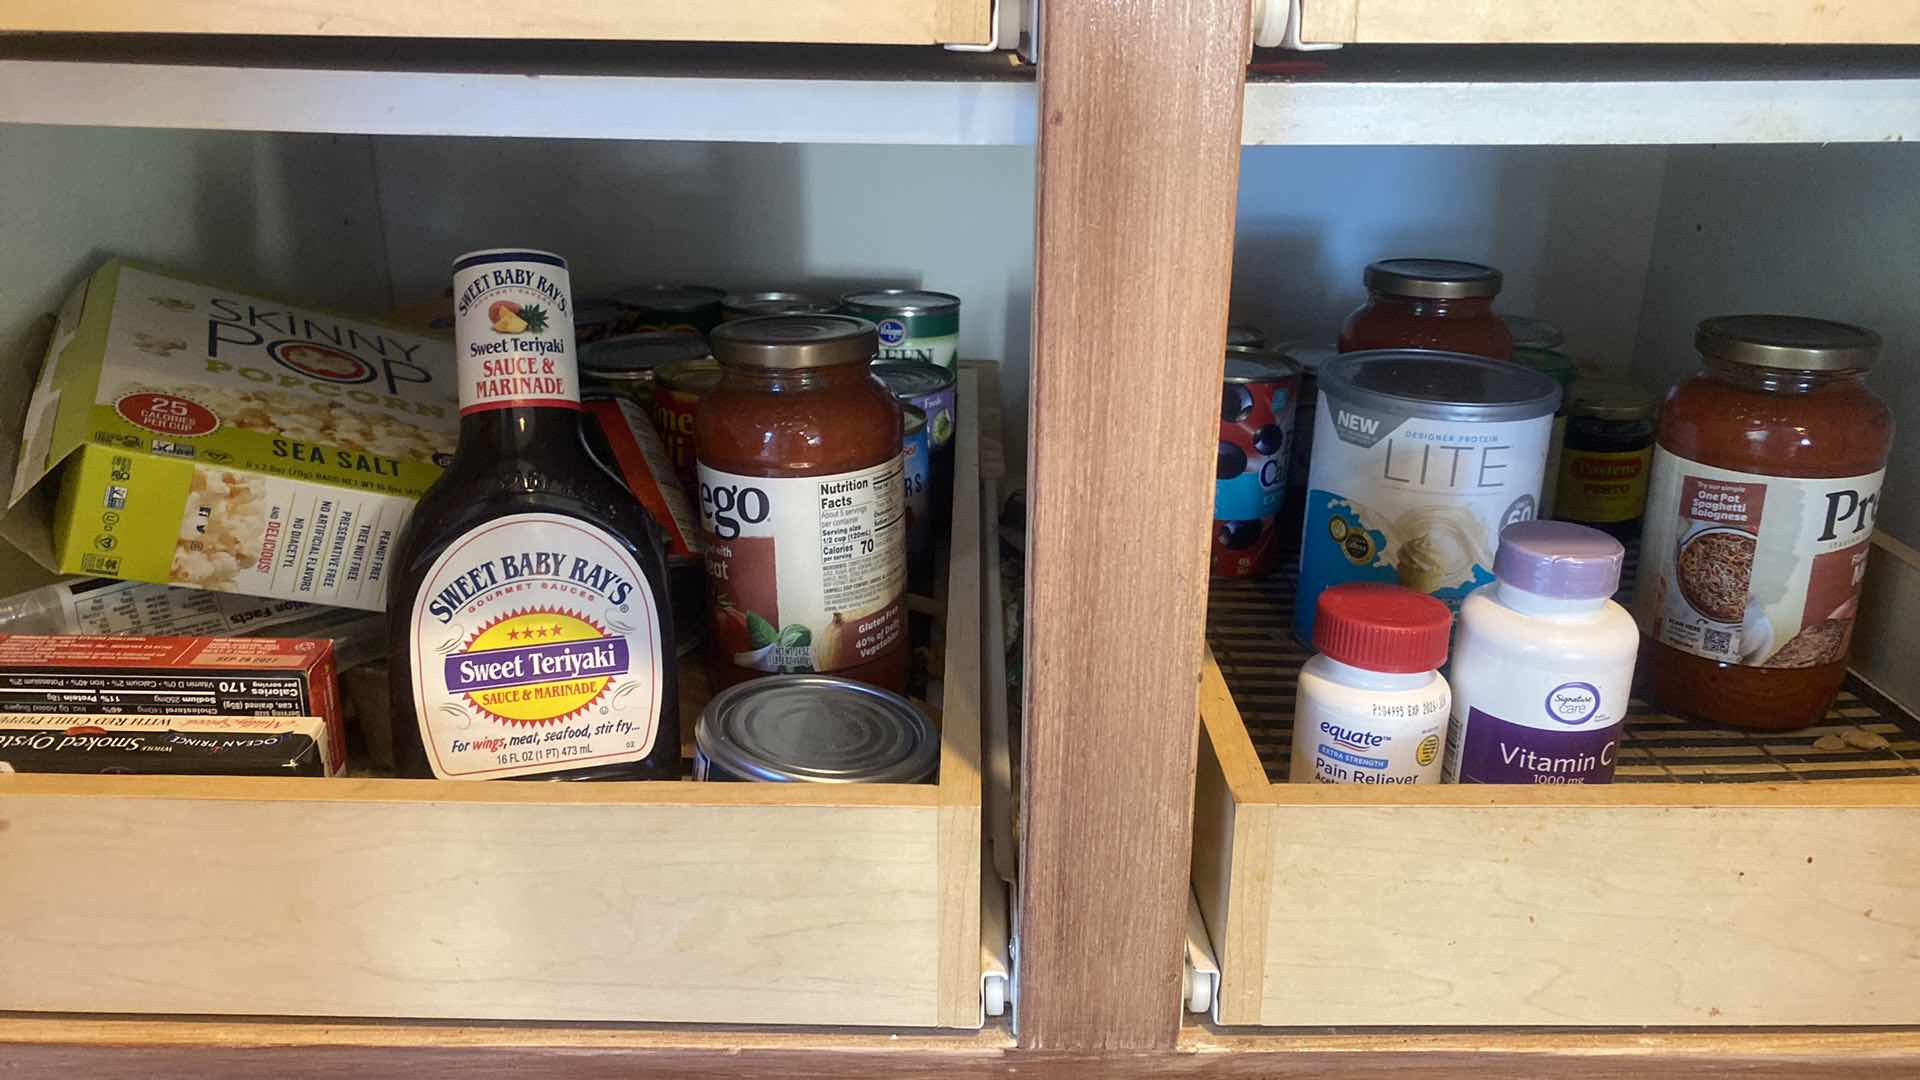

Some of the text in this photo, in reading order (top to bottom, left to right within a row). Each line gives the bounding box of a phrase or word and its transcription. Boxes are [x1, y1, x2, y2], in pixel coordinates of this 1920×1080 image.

[458, 268, 567, 316] SWEET BABY RAY'S
[210, 298, 421, 361] SKINNY
[470, 336, 565, 357] Sweet Teriyaki
[208, 319, 432, 395] POP
[483, 357, 555, 377] SAUCE &
[205, 358, 446, 417] POPCORN
[475, 378, 565, 399] MARINADE
[152, 397, 189, 416] 25
[140, 409, 196, 427] CALORIES
[143, 417, 193, 432] PER CUP
[1337, 410, 1379, 435] NEW
[1406, 431, 1498, 443] DESIGNER PROTEIN
[272, 439, 400, 477] SEA SALT
[1384, 438, 1511, 488] LITE
[820, 480, 868, 496] Nutrition
[1698, 490, 1741, 503] One Pot
[821, 497, 852, 509] Facts
[1692, 498, 1746, 513] Spaghetti
[1691, 507, 1748, 521] Bolognese
[822, 528, 848, 536] Serving
[834, 536, 846, 544] cup
[257, 521, 281, 574] DELICIOUS!
[282, 518, 304, 568] NO DIACETYL
[300, 501, 332, 592] NO ARTIFICIAL FLAVORS
[323, 511, 352, 587] PRESERVATIVE FREE
[823, 539, 874, 555] Calories 70
[346, 524, 372, 581] TREE NUT FREE
[368, 530, 391, 581] PEANUT FREE
[429, 552, 633, 624] SWEET BABY RAY'S
[468, 582, 595, 614] GOURMET SAUCES
[230, 607, 272, 624] Facts
[858, 616, 885, 633] Gluten
[460, 643, 616, 683] Sweet Teriyaki
[9, 678, 23, 686] 2%
[24, 678, 64, 687] Potassium
[71, 678, 88, 687] 40%
[89, 679, 105, 687] Iron
[125, 680, 157, 688] Calcium
[219, 681, 247, 693] 170
[47, 693, 98, 702] Protein 18g
[100, 695, 121, 703] 11%
[251, 688, 298, 697] Calories
[483, 681, 597, 705] SAUCE & MARINADE
[1555, 694, 1592, 707] Signature
[4, 704, 31, 712] Sugars
[275, 702, 294, 710] can,
[1408, 704, 1419, 717] EXP
[46, 716, 172, 727] WITH RED CHILI
[170, 736, 278, 748] OCEAN PRINCE
[452, 740, 471, 753] For
[472, 737, 507, 753] wings,
[509, 733, 540, 746] meat,
[544, 726, 591, 742] seafood,
[594, 724, 613, 736] stir
[1320, 721, 1383, 747] equate
[56, 736, 145, 751] Smoked
[497, 745, 593, 765] 16 FL OZ (1 PT) 473 mL
[1321, 747, 1385, 768] EXTRA STRENGTH
[1500, 741, 1616, 773] Vitamin C
[1316, 757, 1420, 784] Pain Reliever
[1534, 774, 1566, 784] 1000
